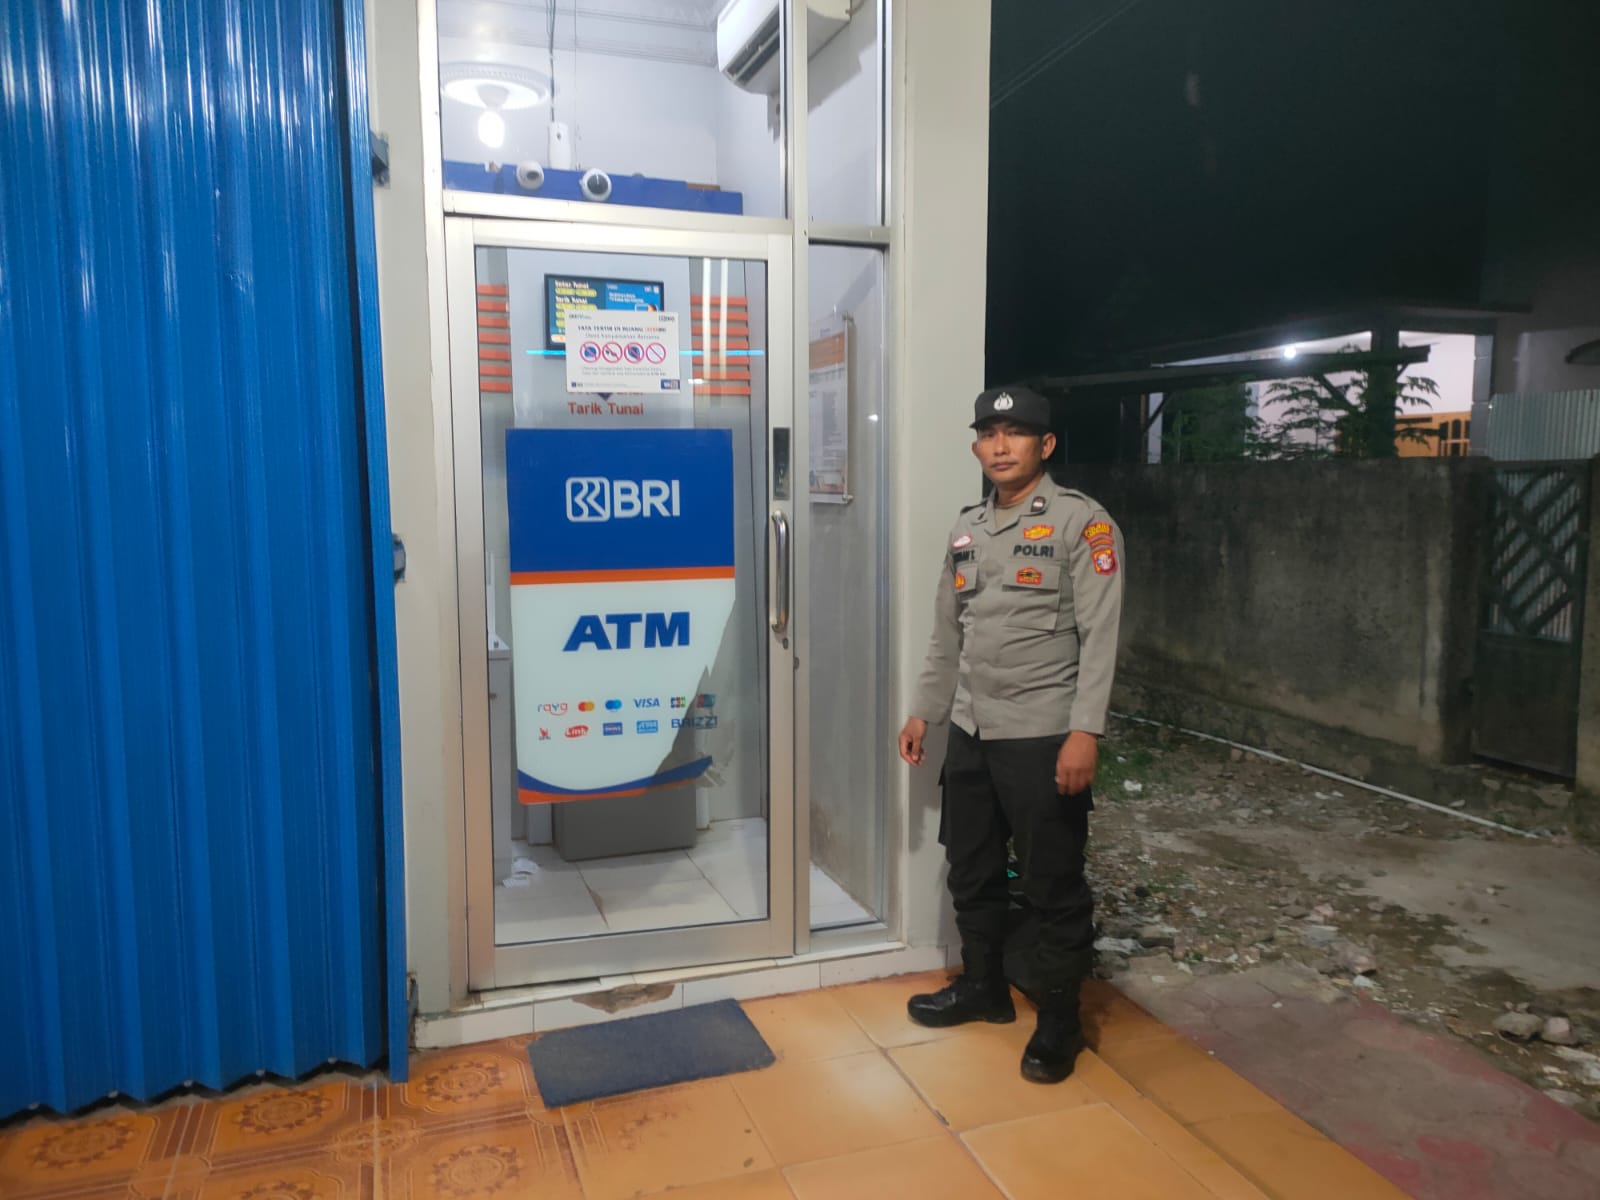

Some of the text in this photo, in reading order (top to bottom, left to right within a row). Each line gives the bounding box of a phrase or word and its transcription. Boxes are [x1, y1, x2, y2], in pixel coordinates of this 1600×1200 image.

[568, 401, 644, 416] Tarik Tunai
[613, 479, 681, 518] BRI
[1013, 544, 1054, 558] POLRI
[562, 611, 691, 652] ATM
[633, 698, 661, 708] VISA
[671, 716, 718, 729] BRIZZI
